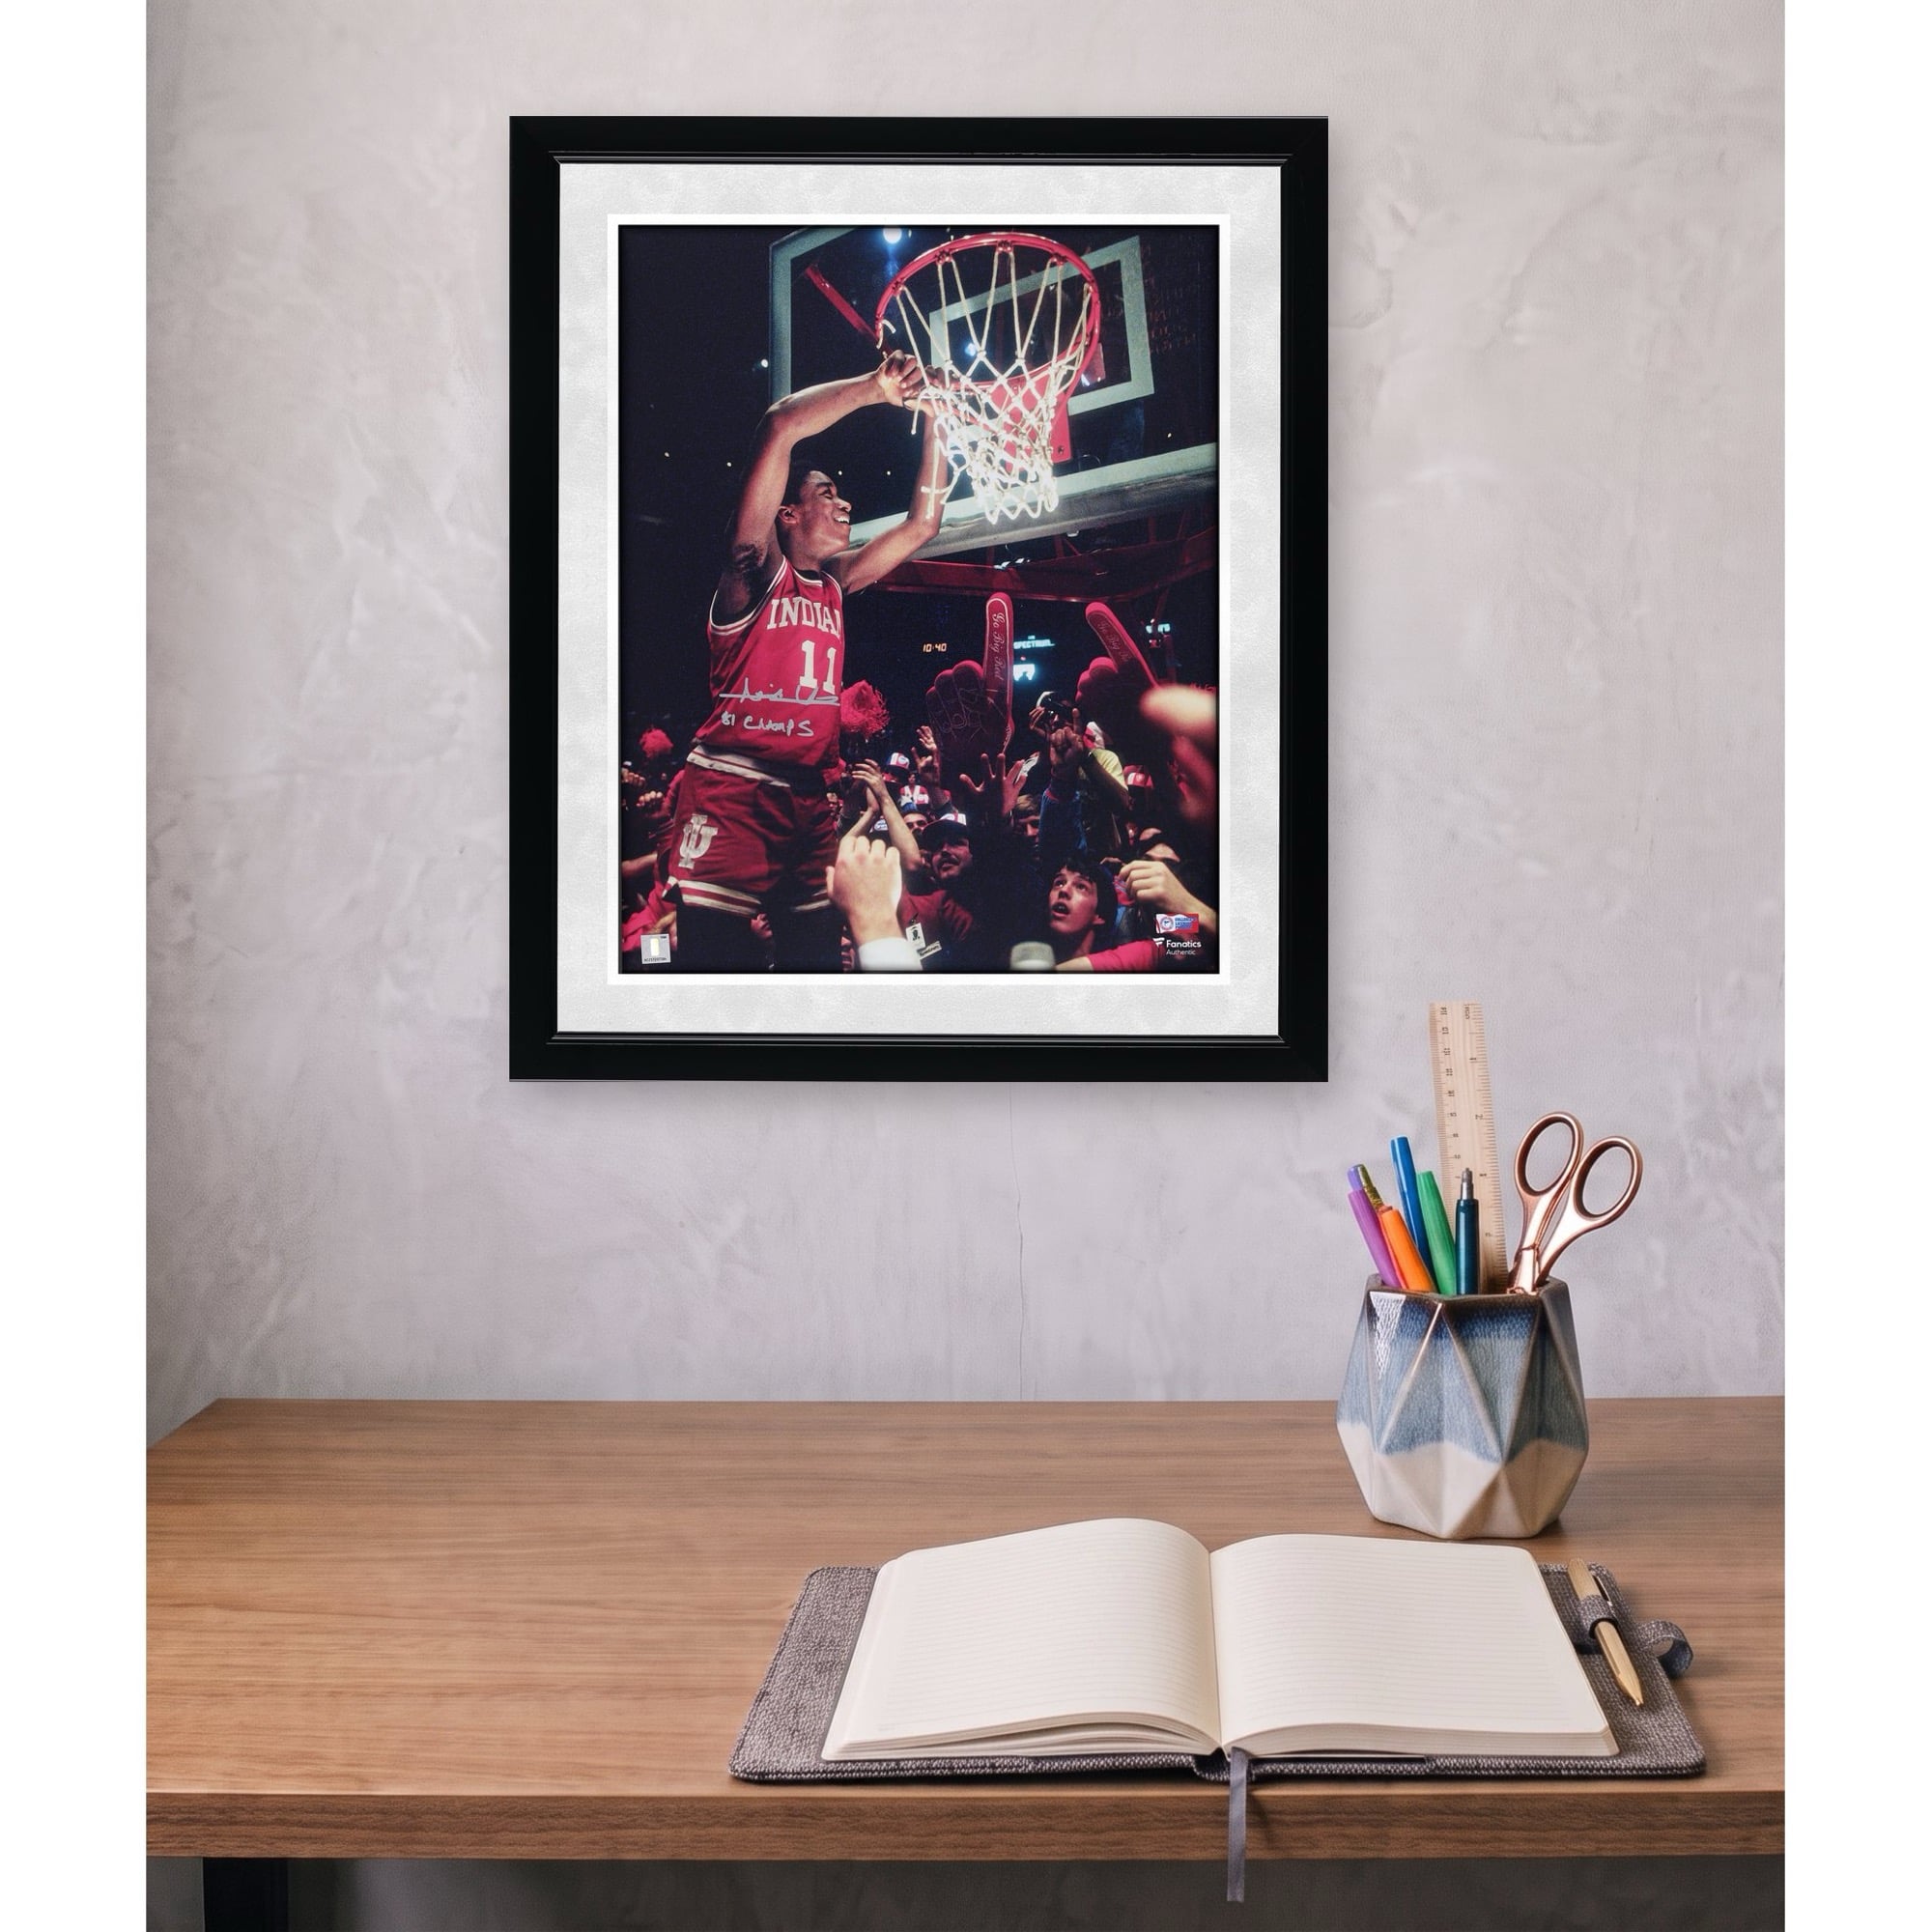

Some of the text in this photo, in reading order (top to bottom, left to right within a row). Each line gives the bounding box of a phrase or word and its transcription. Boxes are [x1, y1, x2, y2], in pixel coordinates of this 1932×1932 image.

[992, 611, 1006, 628] Go
[989, 631, 1005, 653] Big
[799, 639, 837, 695] 11
[1166, 939, 1202, 948] Fanatics
